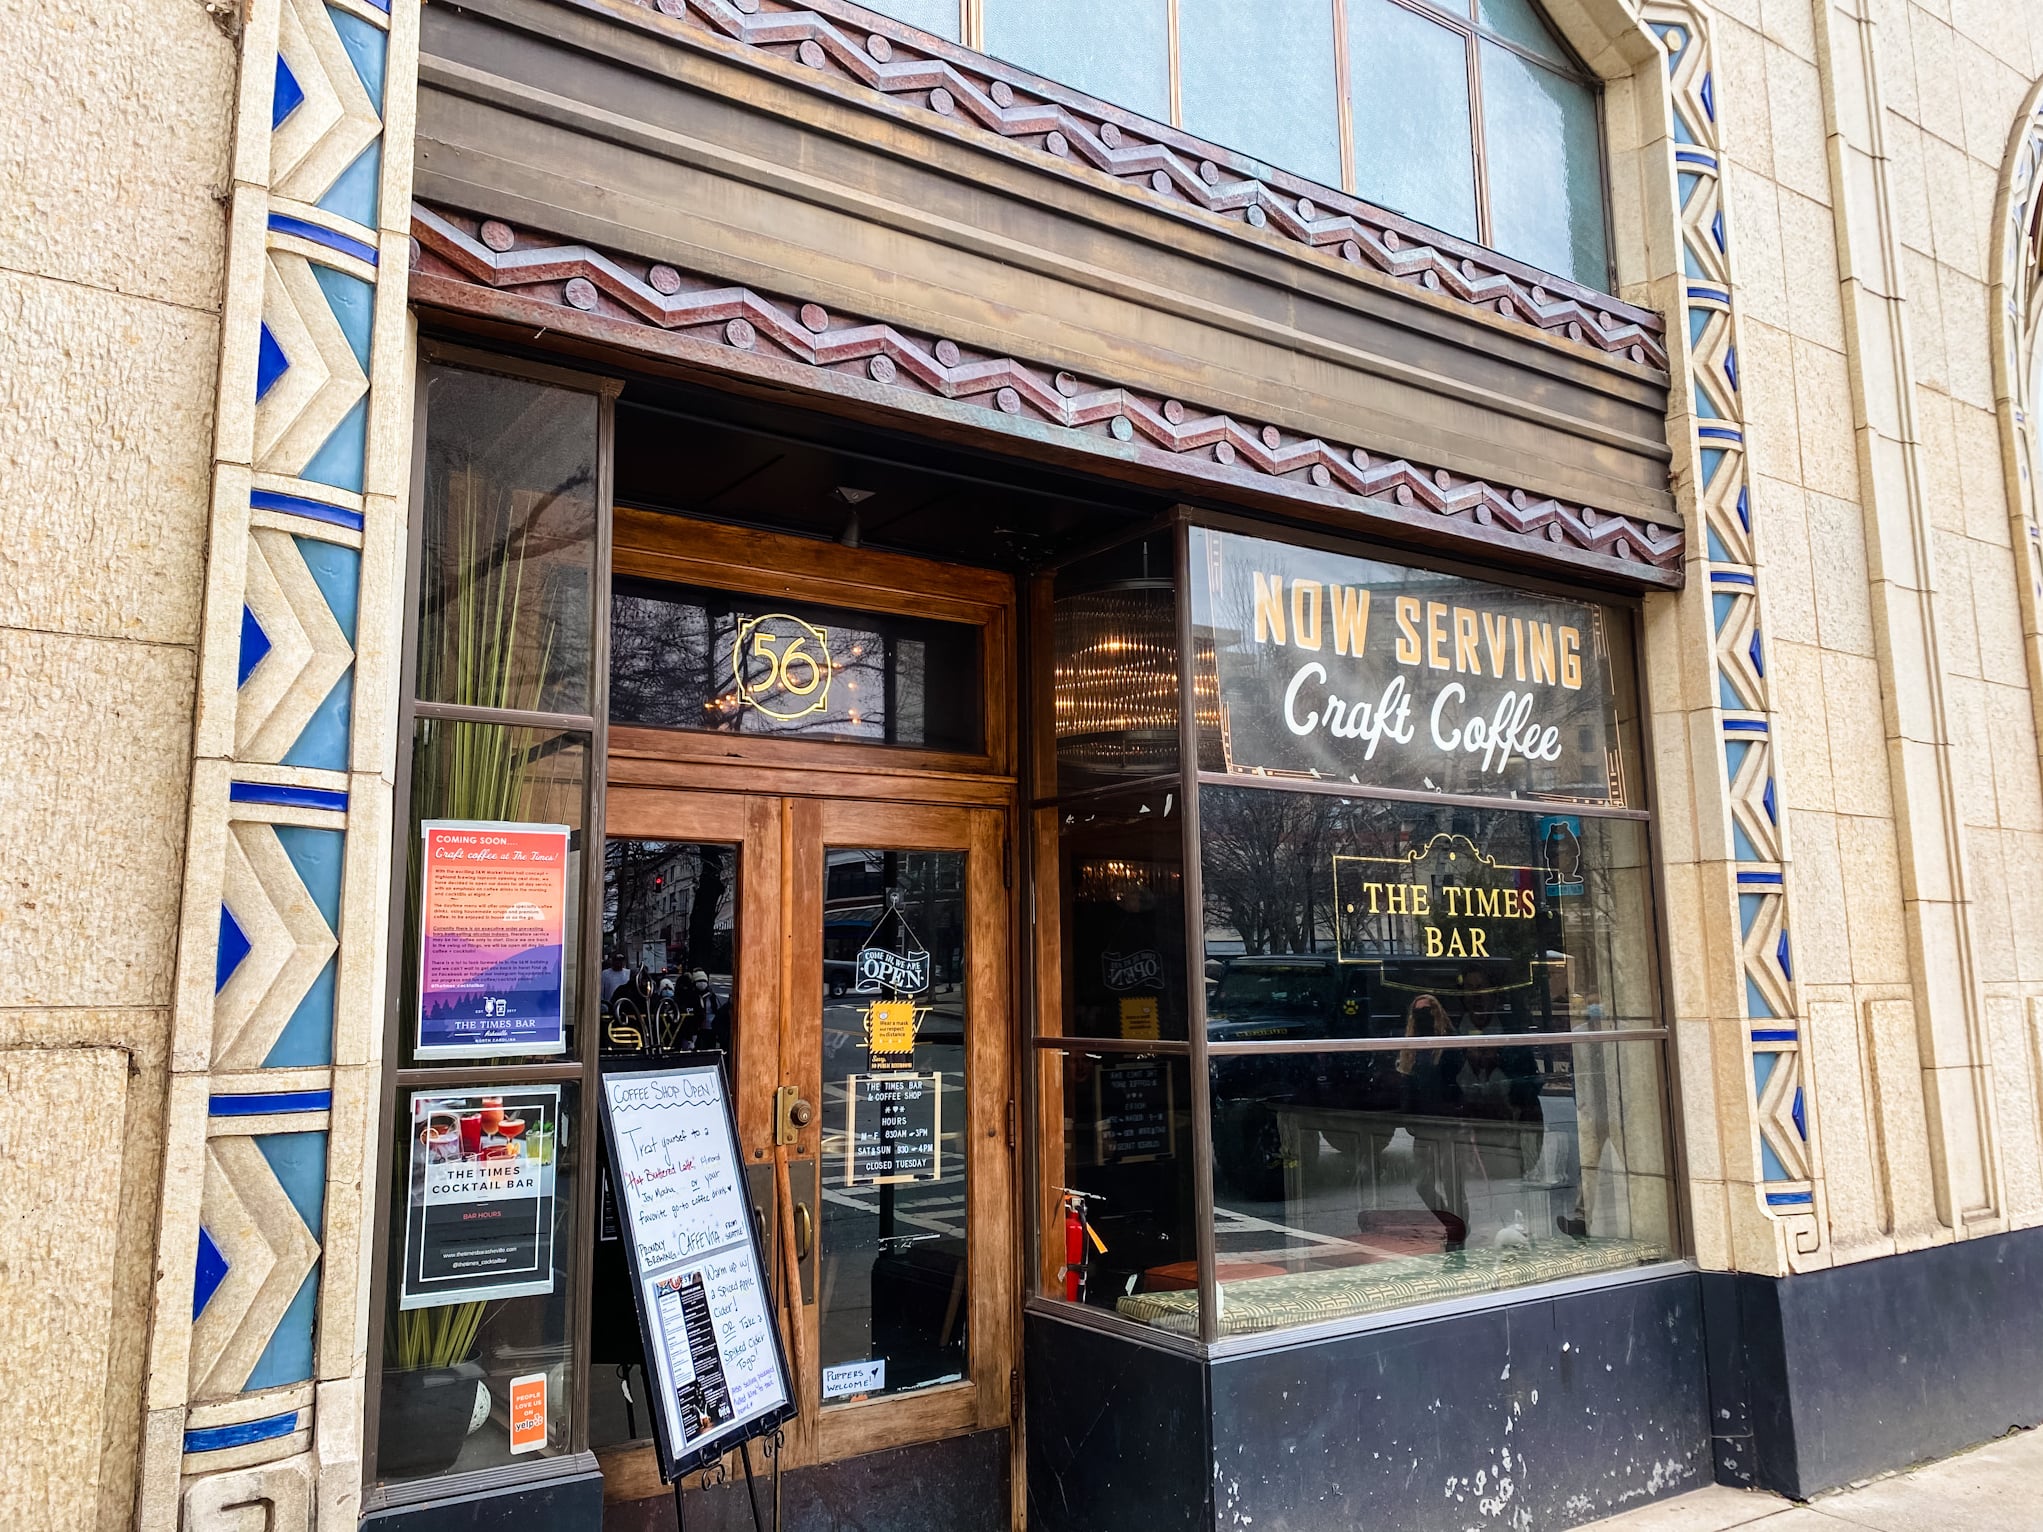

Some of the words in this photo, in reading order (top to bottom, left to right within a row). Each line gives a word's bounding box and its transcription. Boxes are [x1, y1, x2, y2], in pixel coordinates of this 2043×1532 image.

[1252, 571, 1370, 659] NOW
[1396, 596, 1582, 690] SERVING
[752, 633, 819, 695] 56
[1284, 662, 1415, 761] Craft
[1431, 682, 1562, 774] Coffee
[436, 835, 477, 844] COMING
[436, 847, 464, 860] Craft
[468, 849, 497, 860] coffee
[512, 851, 526, 860] The
[530, 851, 558, 861] Times!
[1363, 882, 1429, 916] THE
[1443, 886, 1536, 920] TIMES
[1425, 927, 1490, 959] BAR
[865, 952, 884, 960] COME
[896, 960, 905, 968] WE
[907, 961, 920, 969] ARE
[864, 959, 922, 988] OPEN
[455, 1021, 476, 1029] THE
[480, 1020, 511, 1028] TIMES
[515, 1019, 536, 1027] BAR
[614, 1085, 649, 1103] COFFEE
[651, 1080, 679, 1100] SHOP
[683, 1075, 715, 1098] OPEN!
[866, 1083, 880, 1091] THE
[885, 1082, 904, 1090] TIMES
[909, 1081, 922, 1089] BAR
[905, 1091, 921, 1099] SHOP
[882, 1117, 907, 1126] HOURS
[691, 1129, 701, 1138] to
[885, 1130, 907, 1138] 830AM
[858, 1146, 891, 1155] SAT&SUN
[866, 1161, 892, 1170] CLOSED
[896, 1159, 926, 1168] TUESDAY
[448, 1170, 473, 1179] THE
[480, 1167, 520, 1177] TIMES
[705, 1171, 720, 1188] your
[433, 1182, 501, 1193] COCKTAIL
[507, 1179, 533, 1188] BAR
[639, 1210, 667, 1225] favorite
[692, 1195, 710, 1206] coffee
[639, 1240, 665, 1257] PROUDLY
[645, 1251, 677, 1267] BREWING
[704, 1265, 727, 1280] Warm
[729, 1262, 737, 1273] up
[711, 1290, 715, 1299] a
[718, 1281, 738, 1297] Spiced
[722, 1321, 735, 1334] OR
[739, 1316, 755, 1329] Take
[827, 1370, 863, 1381] PUPPERS
[827, 1376, 872, 1392] WELCOME!
[516, 1392, 540, 1401] PEOPLE
[516, 1402, 532, 1410] LOVE
[515, 1420, 533, 1431] yelp
